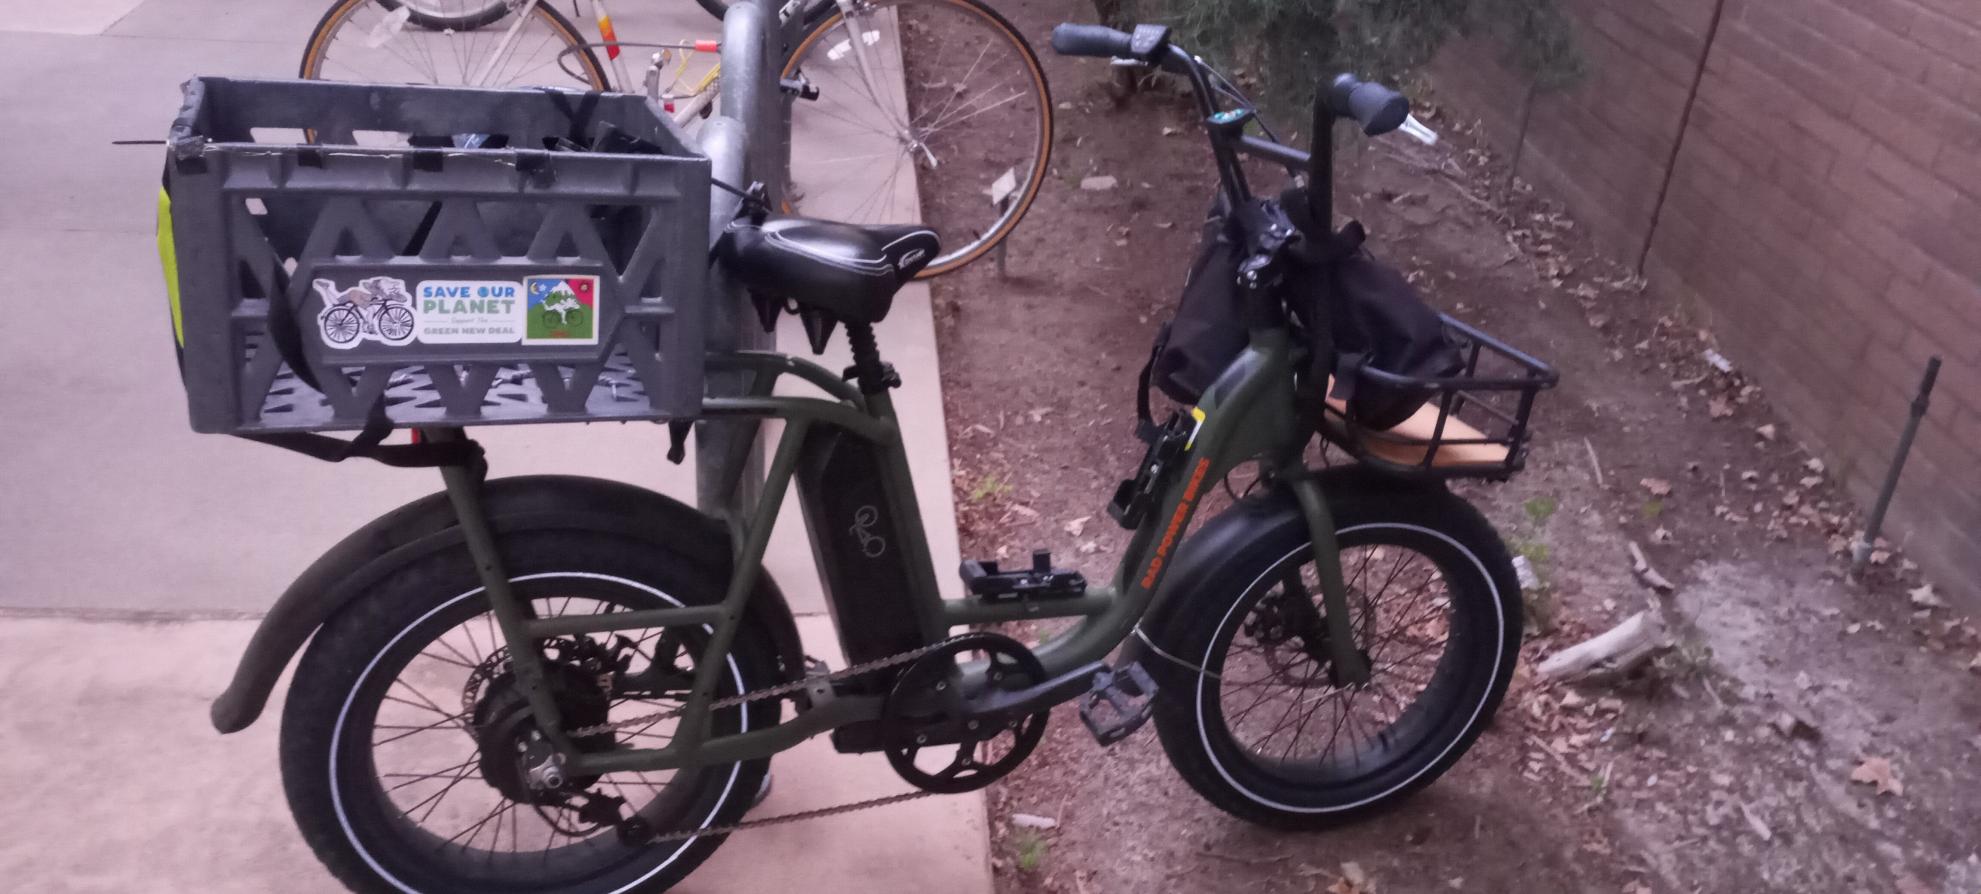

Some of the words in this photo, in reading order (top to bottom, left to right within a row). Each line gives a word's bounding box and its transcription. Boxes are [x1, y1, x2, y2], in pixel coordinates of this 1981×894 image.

[423, 286, 470, 298] SAVE
[477, 286, 515, 298] OUR
[423, 299, 515, 314] PLANET
[424, 327, 459, 335] GREEN
[461, 327, 486, 335] NEW
[488, 327, 515, 335] DEAL
[1141, 557, 1162, 589] RAD
[1157, 502, 1188, 556] POWER
[1184, 457, 1210, 501] BIKES
